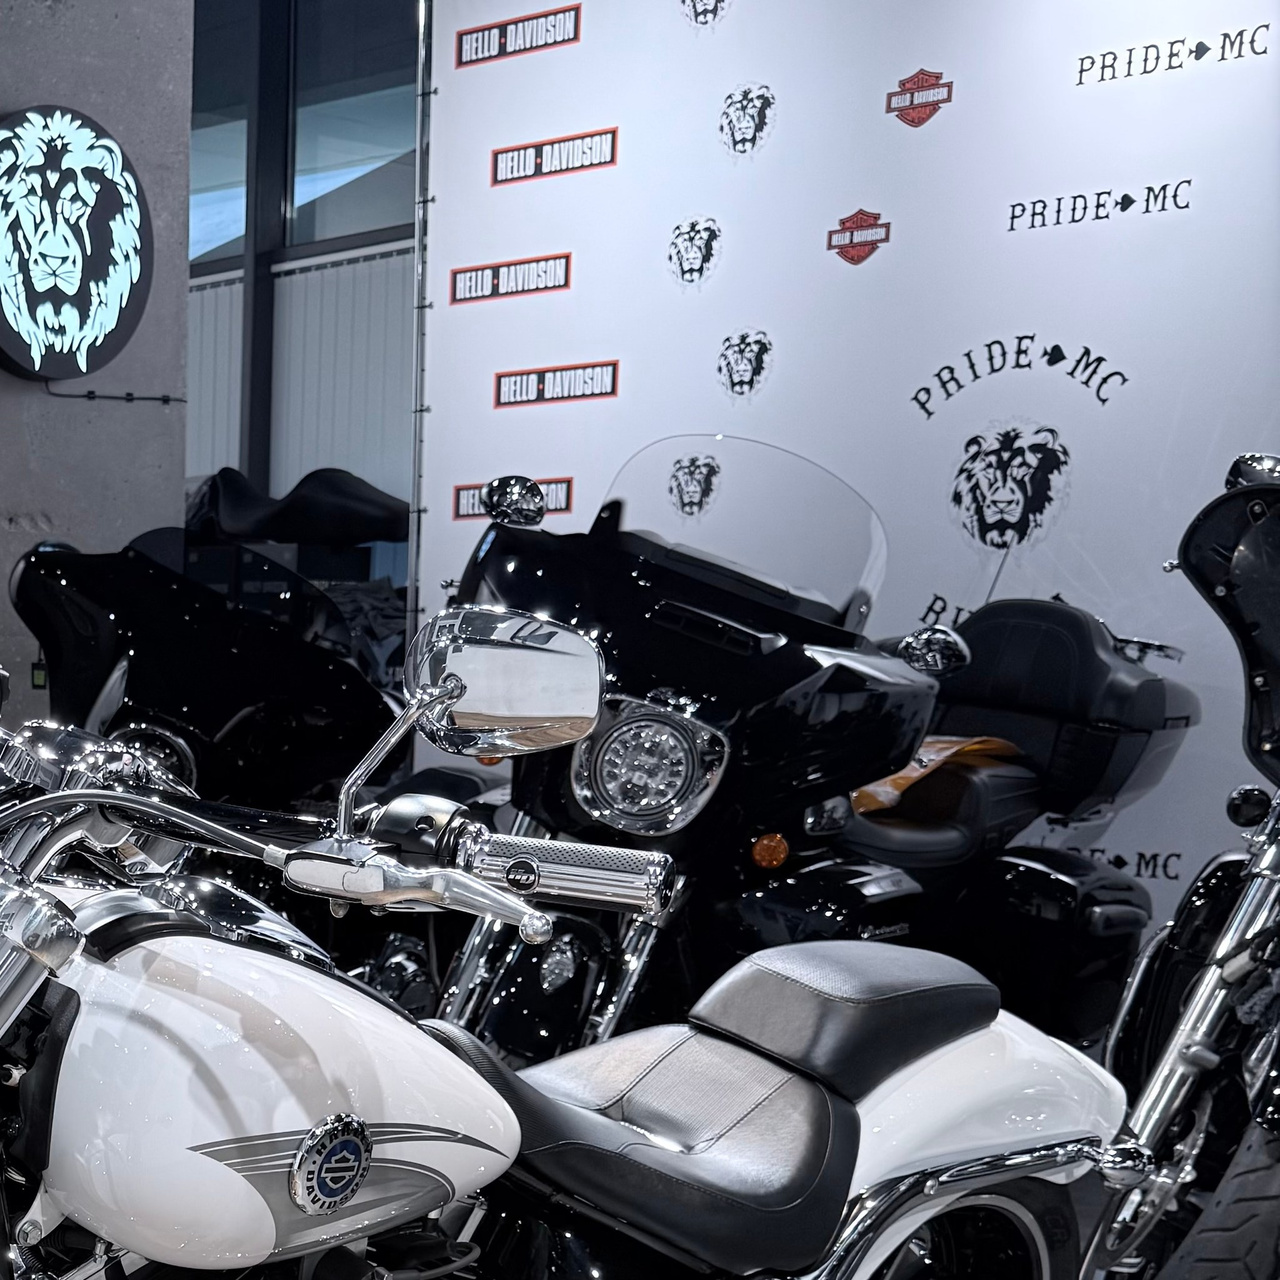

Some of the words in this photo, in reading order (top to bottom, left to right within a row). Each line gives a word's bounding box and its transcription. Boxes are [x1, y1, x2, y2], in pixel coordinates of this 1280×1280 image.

[461, 28, 500, 63] HELLO
[506, 10, 577, 52] DAVIDSON
[1075, 37, 1187, 87] PRIDE
[1217, 23, 1271, 62] MC
[496, 148, 536, 181] HELLO
[541, 133, 613, 174] DAVIDSON
[1007, 189, 1113, 232] PRIDE
[1141, 179, 1193, 215] MC
[455, 268, 493, 300] HELLO
[498, 257, 567, 294] DAVIDSON
[499, 373, 539, 404] HELLO
[543, 365, 614, 400] DAVIDSON
[910, 333, 1037, 420] PRIDE
[1066, 345, 1130, 406] MC
[458, 488, 486, 516] HEL
[1134, 851, 1182, 880] MC
